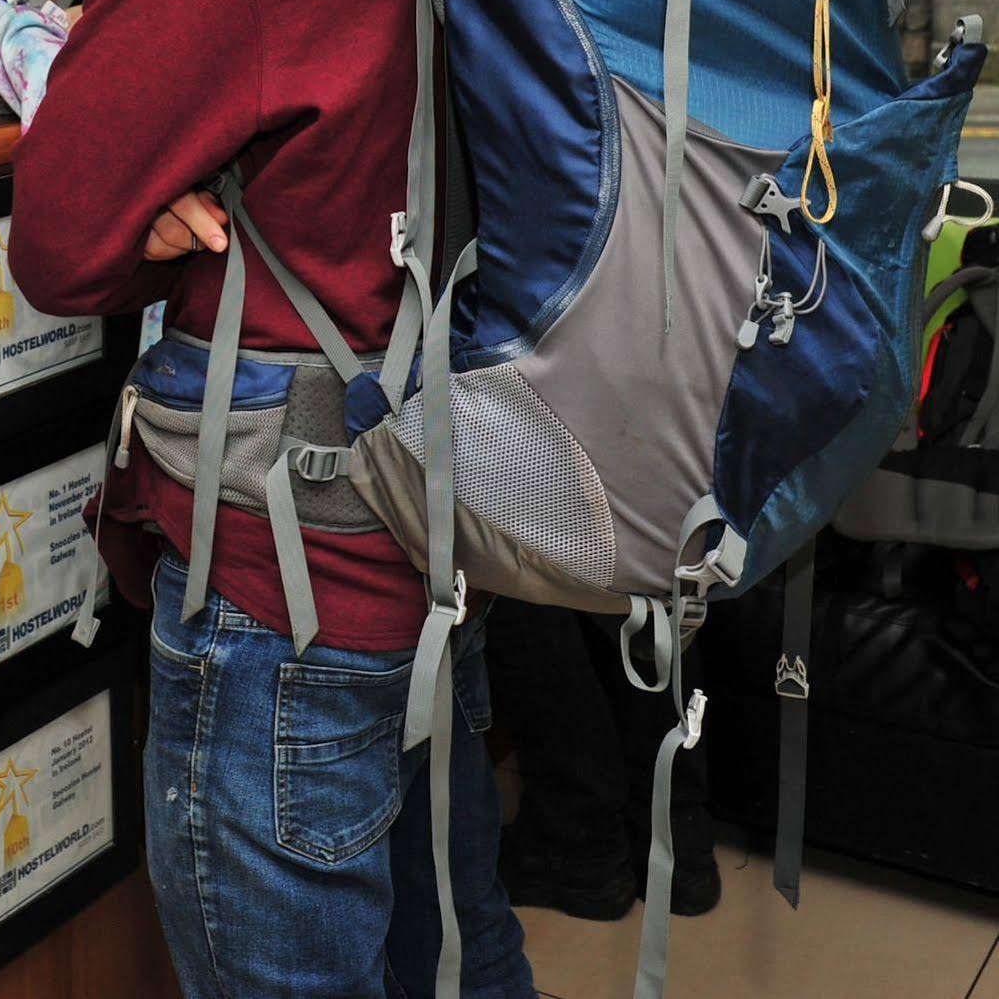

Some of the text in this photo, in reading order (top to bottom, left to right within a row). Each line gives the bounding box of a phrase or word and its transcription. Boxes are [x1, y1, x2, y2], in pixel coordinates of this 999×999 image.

[68, 474, 91, 491] Hostel
[50, 549, 76, 565] Galway
[0, 592, 20, 611] 1st
